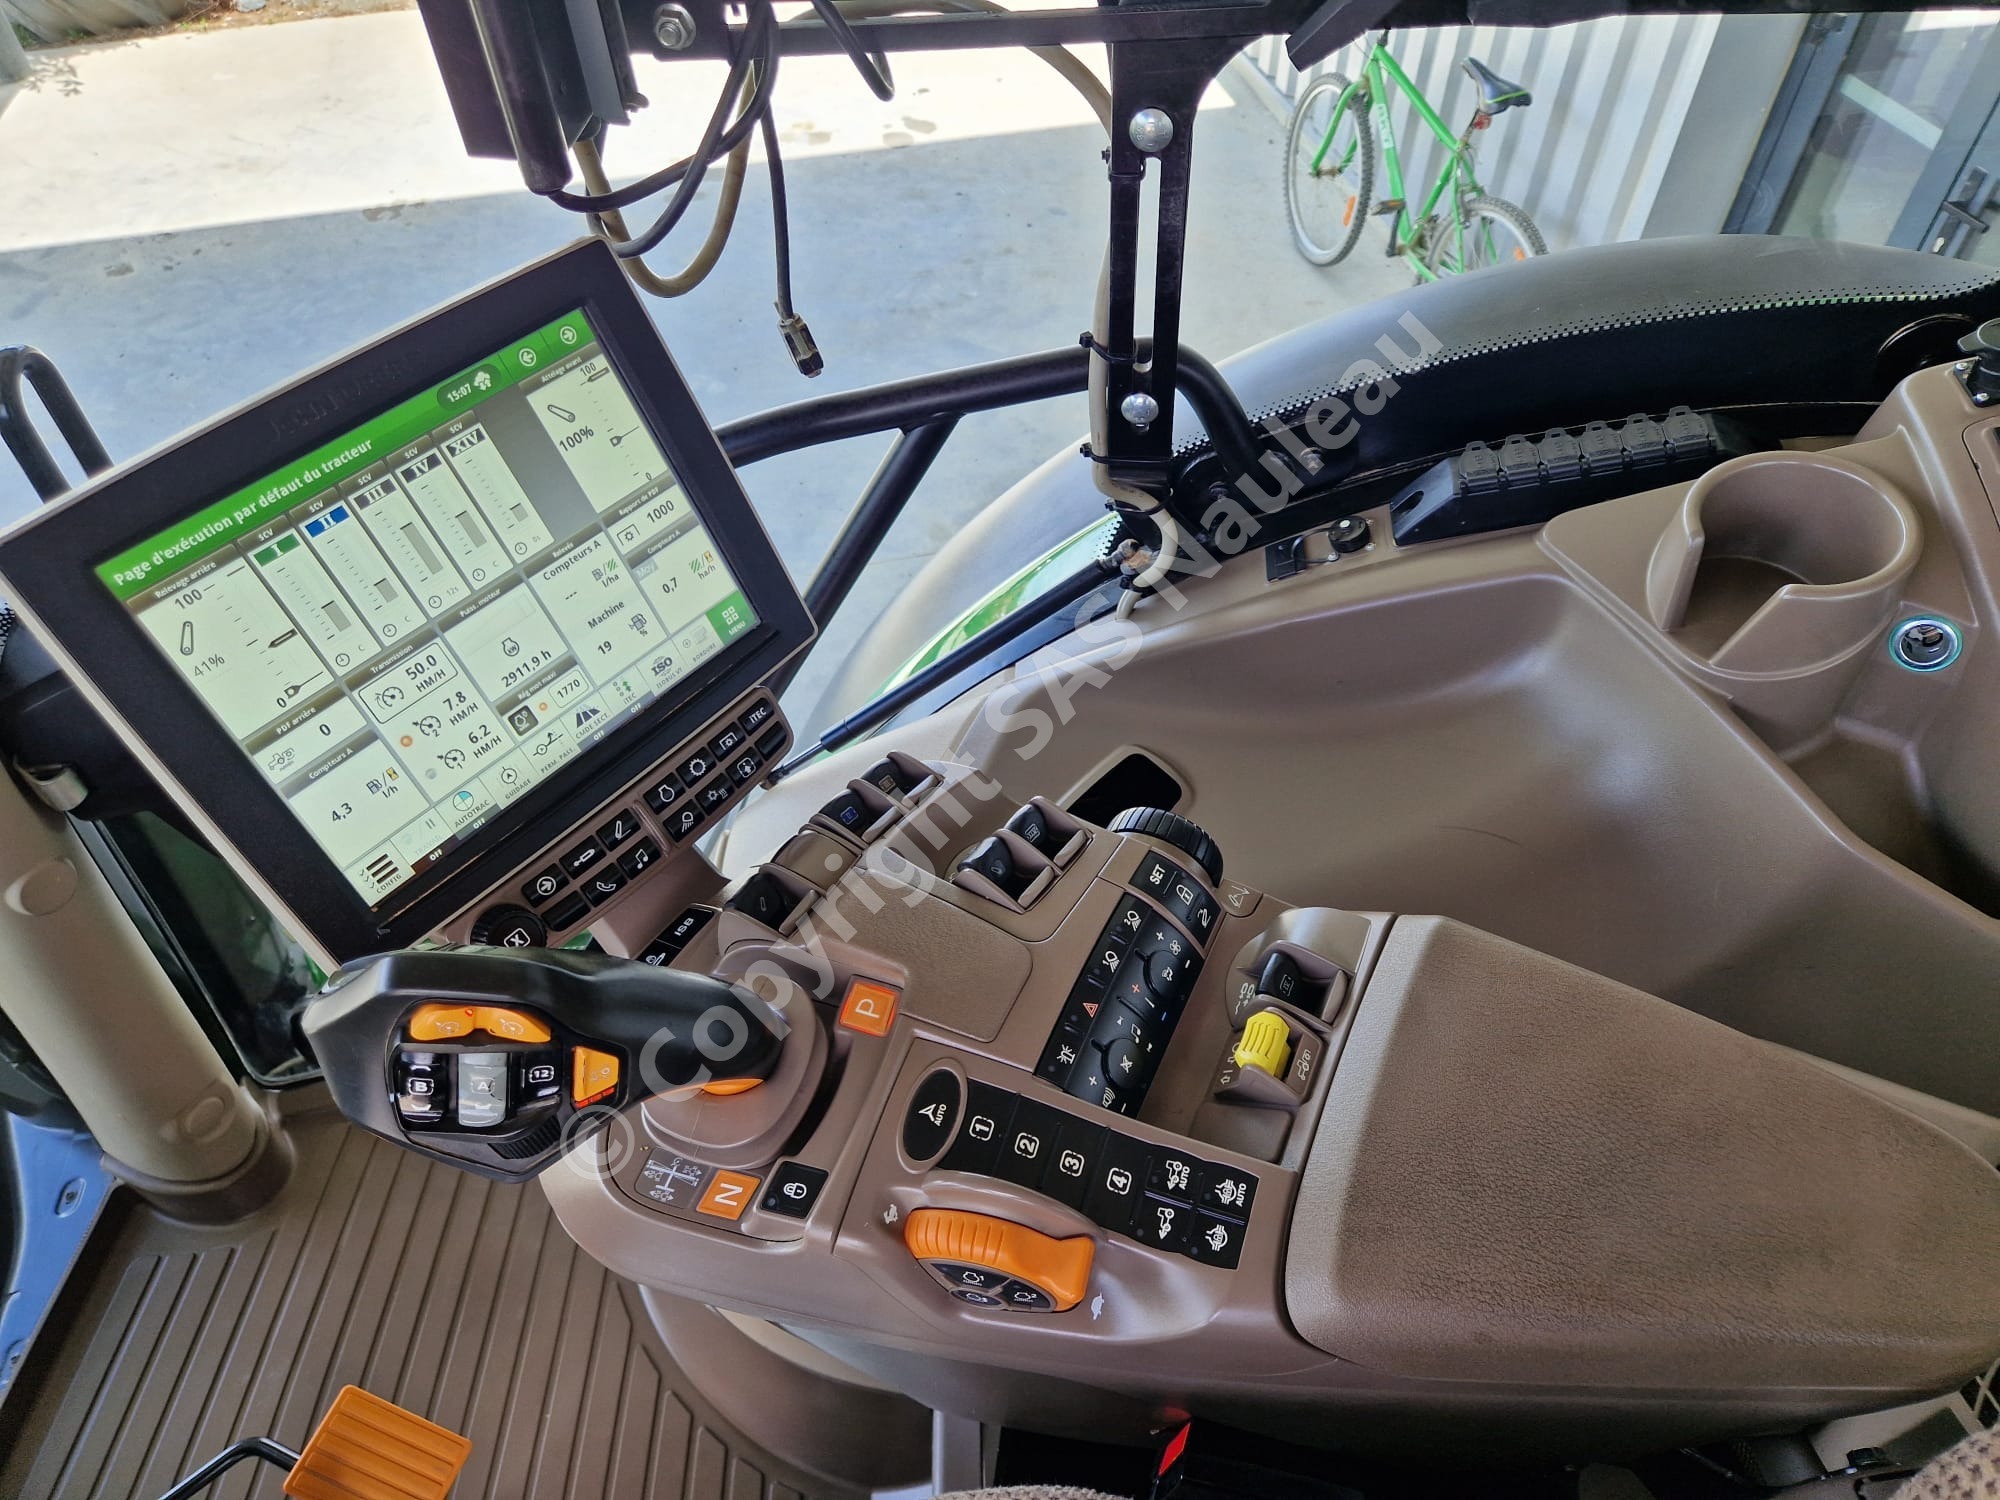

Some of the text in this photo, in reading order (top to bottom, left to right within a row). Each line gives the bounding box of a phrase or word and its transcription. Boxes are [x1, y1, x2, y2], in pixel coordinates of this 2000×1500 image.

[541, 356, 581, 382] Attelage avant
[579, 362, 596, 376] 100
[447, 383, 471, 401] 15:07
[449, 421, 462, 433] SCV
[449, 429, 482, 456] XIV
[559, 425, 593, 450] 100%
[404, 446, 417, 458] SCV
[410, 457, 432, 478] IV
[645, 472, 652, 481] 0
[357, 472, 371, 485] SCV
[362, 483, 387, 505] III
[113, 440, 371, 585] Page d'exécution par défaut du tracteur
[308, 499, 323, 512] SCV
[618, 499, 640, 515] Rapport
[647, 500, 673, 522] 1000
[318, 512, 336, 530] II
[258, 528, 273, 540] SCV
[647, 533, 675, 553] Compteurs
[543, 540, 600, 580] Compteurs A
[154, 562, 216, 597] Relevage arrière
[601, 574, 619, 587] l/ha
[697, 565, 715, 579] ha/h
[662, 577, 676, 593] 0,7
[174, 589, 202, 608] 100
[478, 588, 500, 605] moteur
[587, 601, 624, 628] Machine
[639, 628, 647, 636] %
[728, 620, 745, 635] MENU
[505, 644, 518, 653] kW
[597, 640, 611, 654] 19
[194, 653, 224, 675] 41%
[370, 645, 412, 672] Transmission
[405, 654, 436, 680] 50.0
[651, 657, 672, 675] ISO
[501, 650, 551, 687] 2911,9 h
[415, 669, 445, 692] HM/H
[528, 681, 542, 692] mot
[557, 679, 580, 697] 1770
[276, 697, 286, 707] 0
[442, 691, 466, 710] 7.8
[630, 702, 640, 712] OFF
[275, 707, 315, 734] PDF arrière
[449, 702, 478, 725] HM/H
[748, 706, 768, 725] iTEC
[319, 723, 330, 735] 0
[468, 724, 490, 743] 6.2
[575, 724, 593, 739] CMDE
[593, 729, 604, 741] OFF
[473, 735, 501, 758] HM/H
[308, 753, 346, 778] Compteurs
[540, 759, 556, 773] PERM.
[382, 785, 398, 798] l/h
[505, 778, 531, 799] GUIDAGE
[332, 802, 352, 821] 4,3
[455, 800, 489, 827] AUTOTRAC
[472, 817, 486, 829] OFF
[429, 848, 442, 860] OFF
[376, 873, 401, 893] CONFIG
[1150, 864, 1166, 885] SET
[674, 917, 694, 937] ISB
[508, 932, 525, 947] X
[855, 998, 880, 1020] P
[534, 1069, 550, 1079] 12
[416, 1081, 427, 1092] B
[478, 1081, 489, 1091] A
[934, 1104, 947, 1126] AUTO
[975, 1122, 990, 1133] 1
[1019, 1138, 1035, 1153] 2
[1064, 1156, 1080, 1171] 3
[1112, 1173, 1128, 1188] 4
[1179, 1165, 1191, 1190] AUTO
[714, 1183, 743, 1206] N
[1236, 1182, 1247, 1207] AUTO
